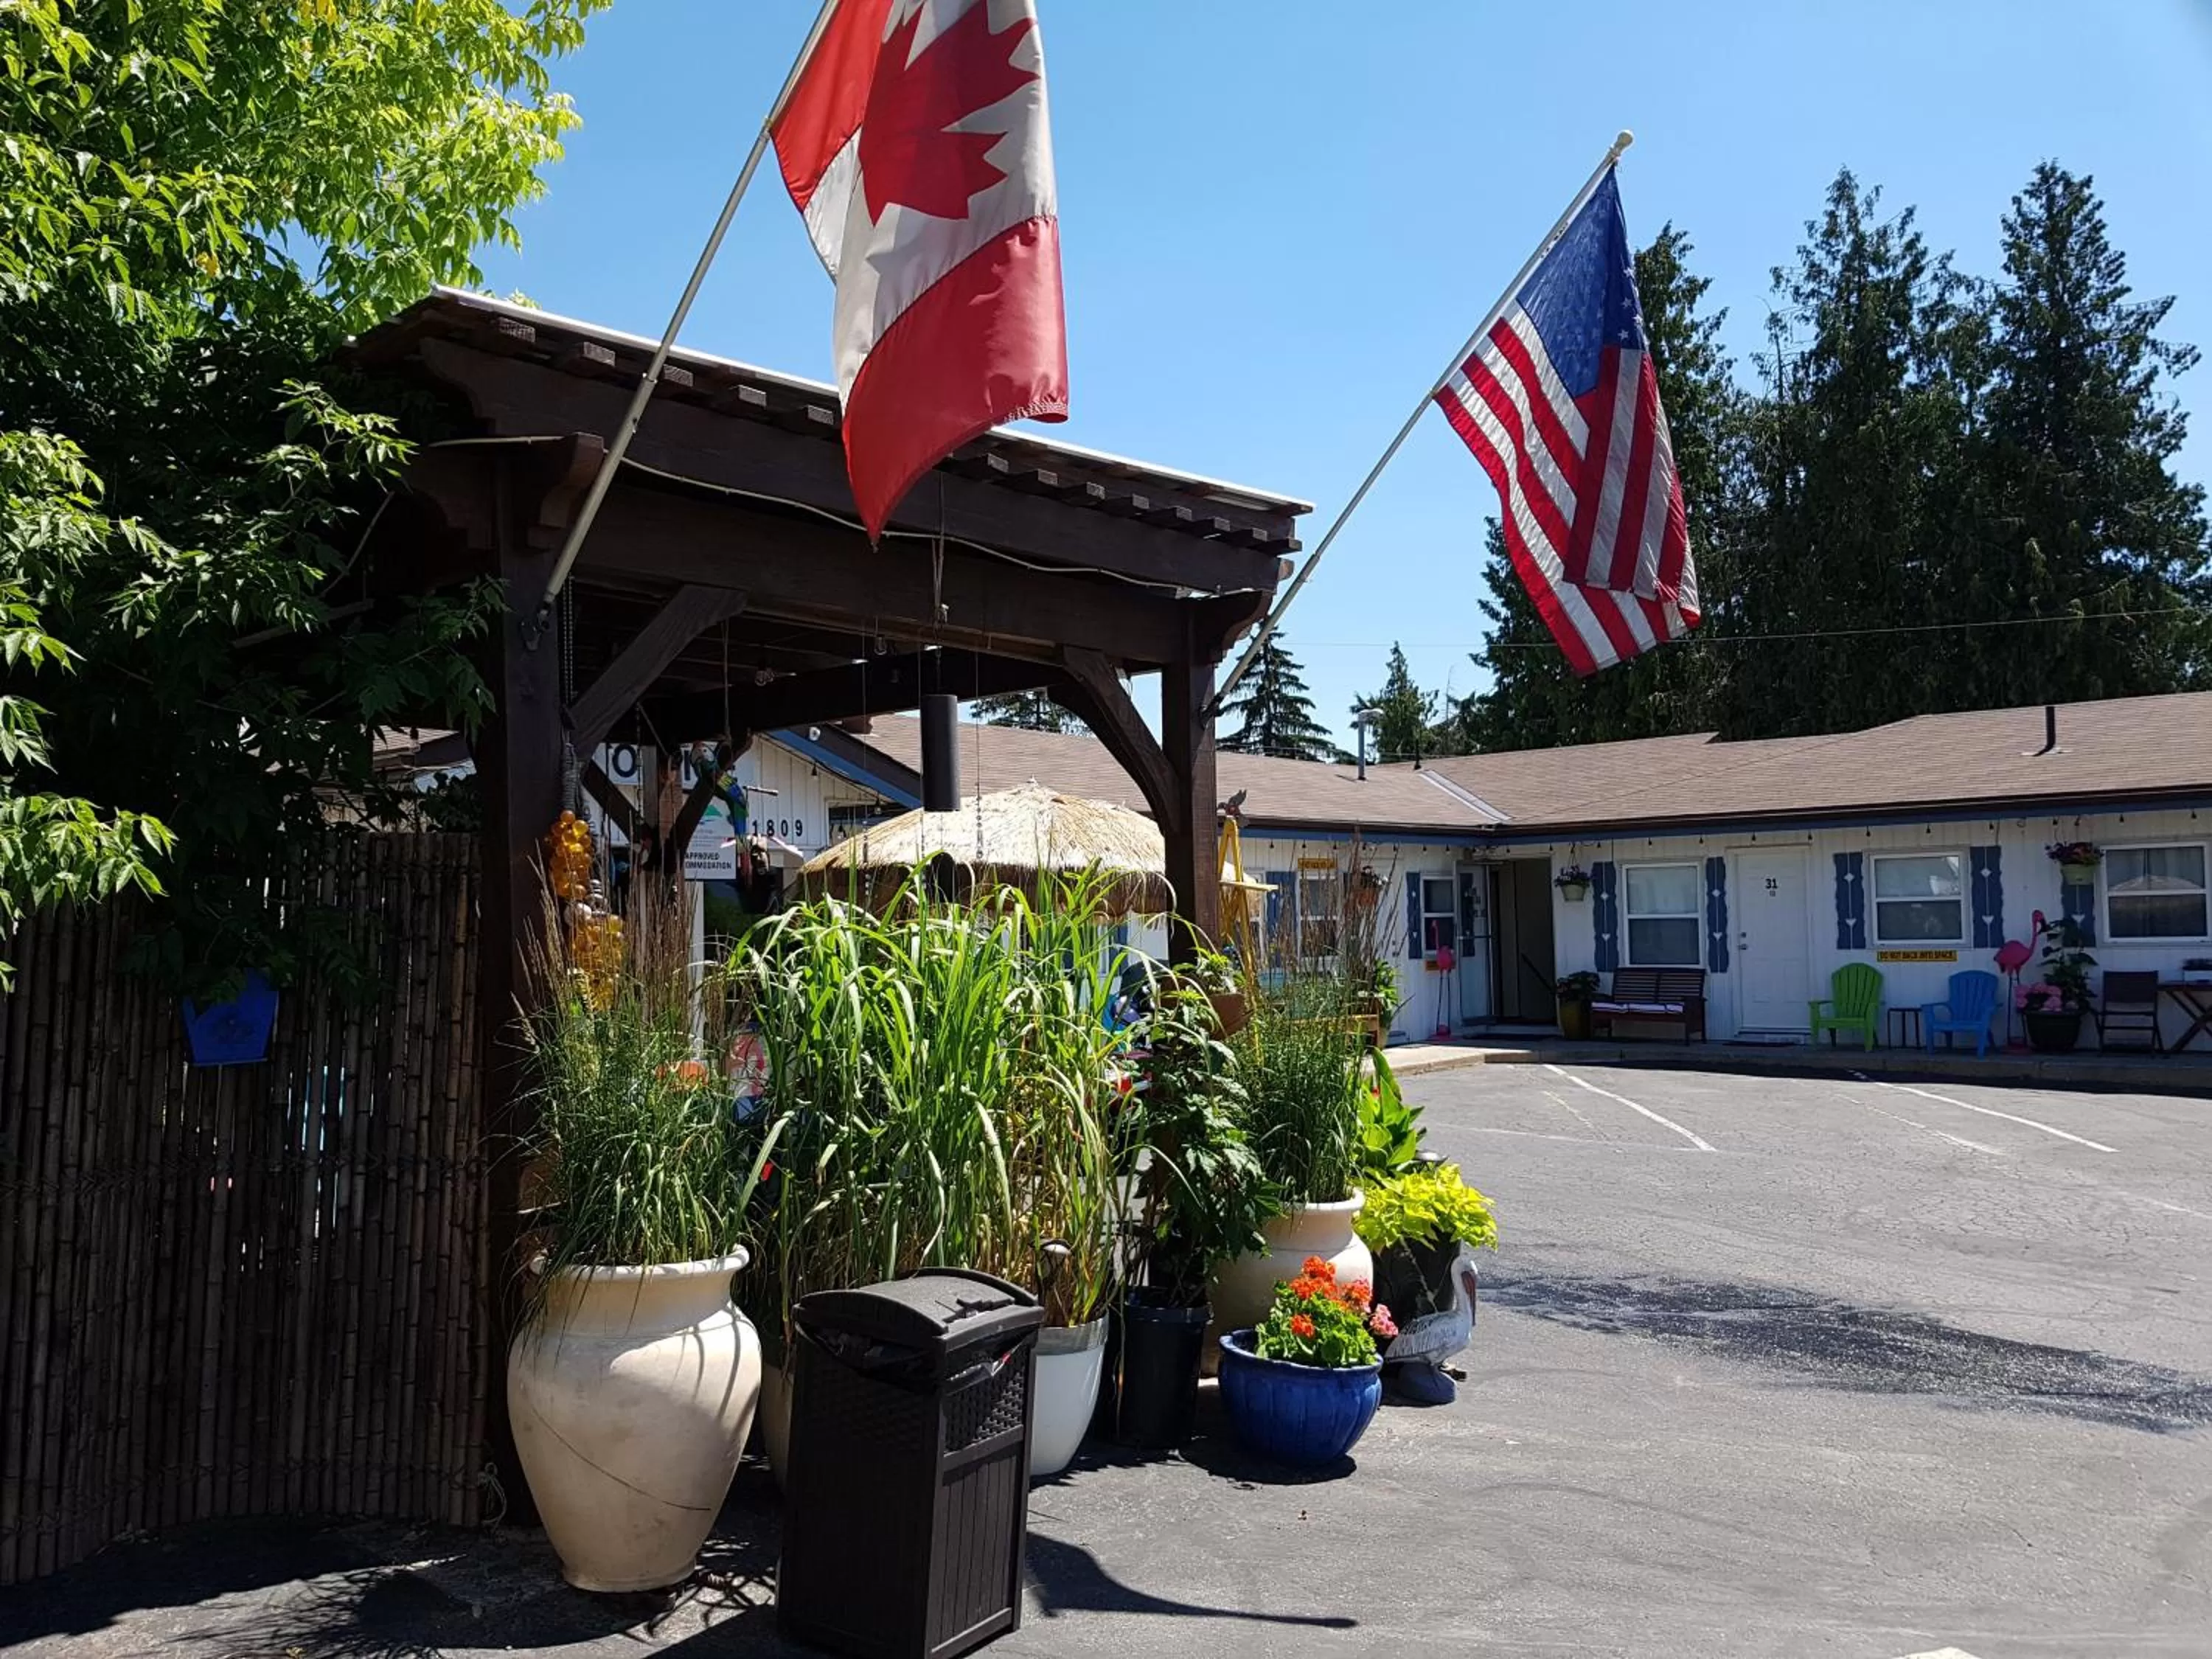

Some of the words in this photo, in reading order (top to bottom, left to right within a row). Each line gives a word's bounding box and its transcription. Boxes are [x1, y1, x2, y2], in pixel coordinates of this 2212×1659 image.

[752, 819, 803, 837] 1809
[685, 852, 720, 860] APPROVED
[685, 860, 731, 869] OMMODATION
[1765, 878, 1778, 888] 31
